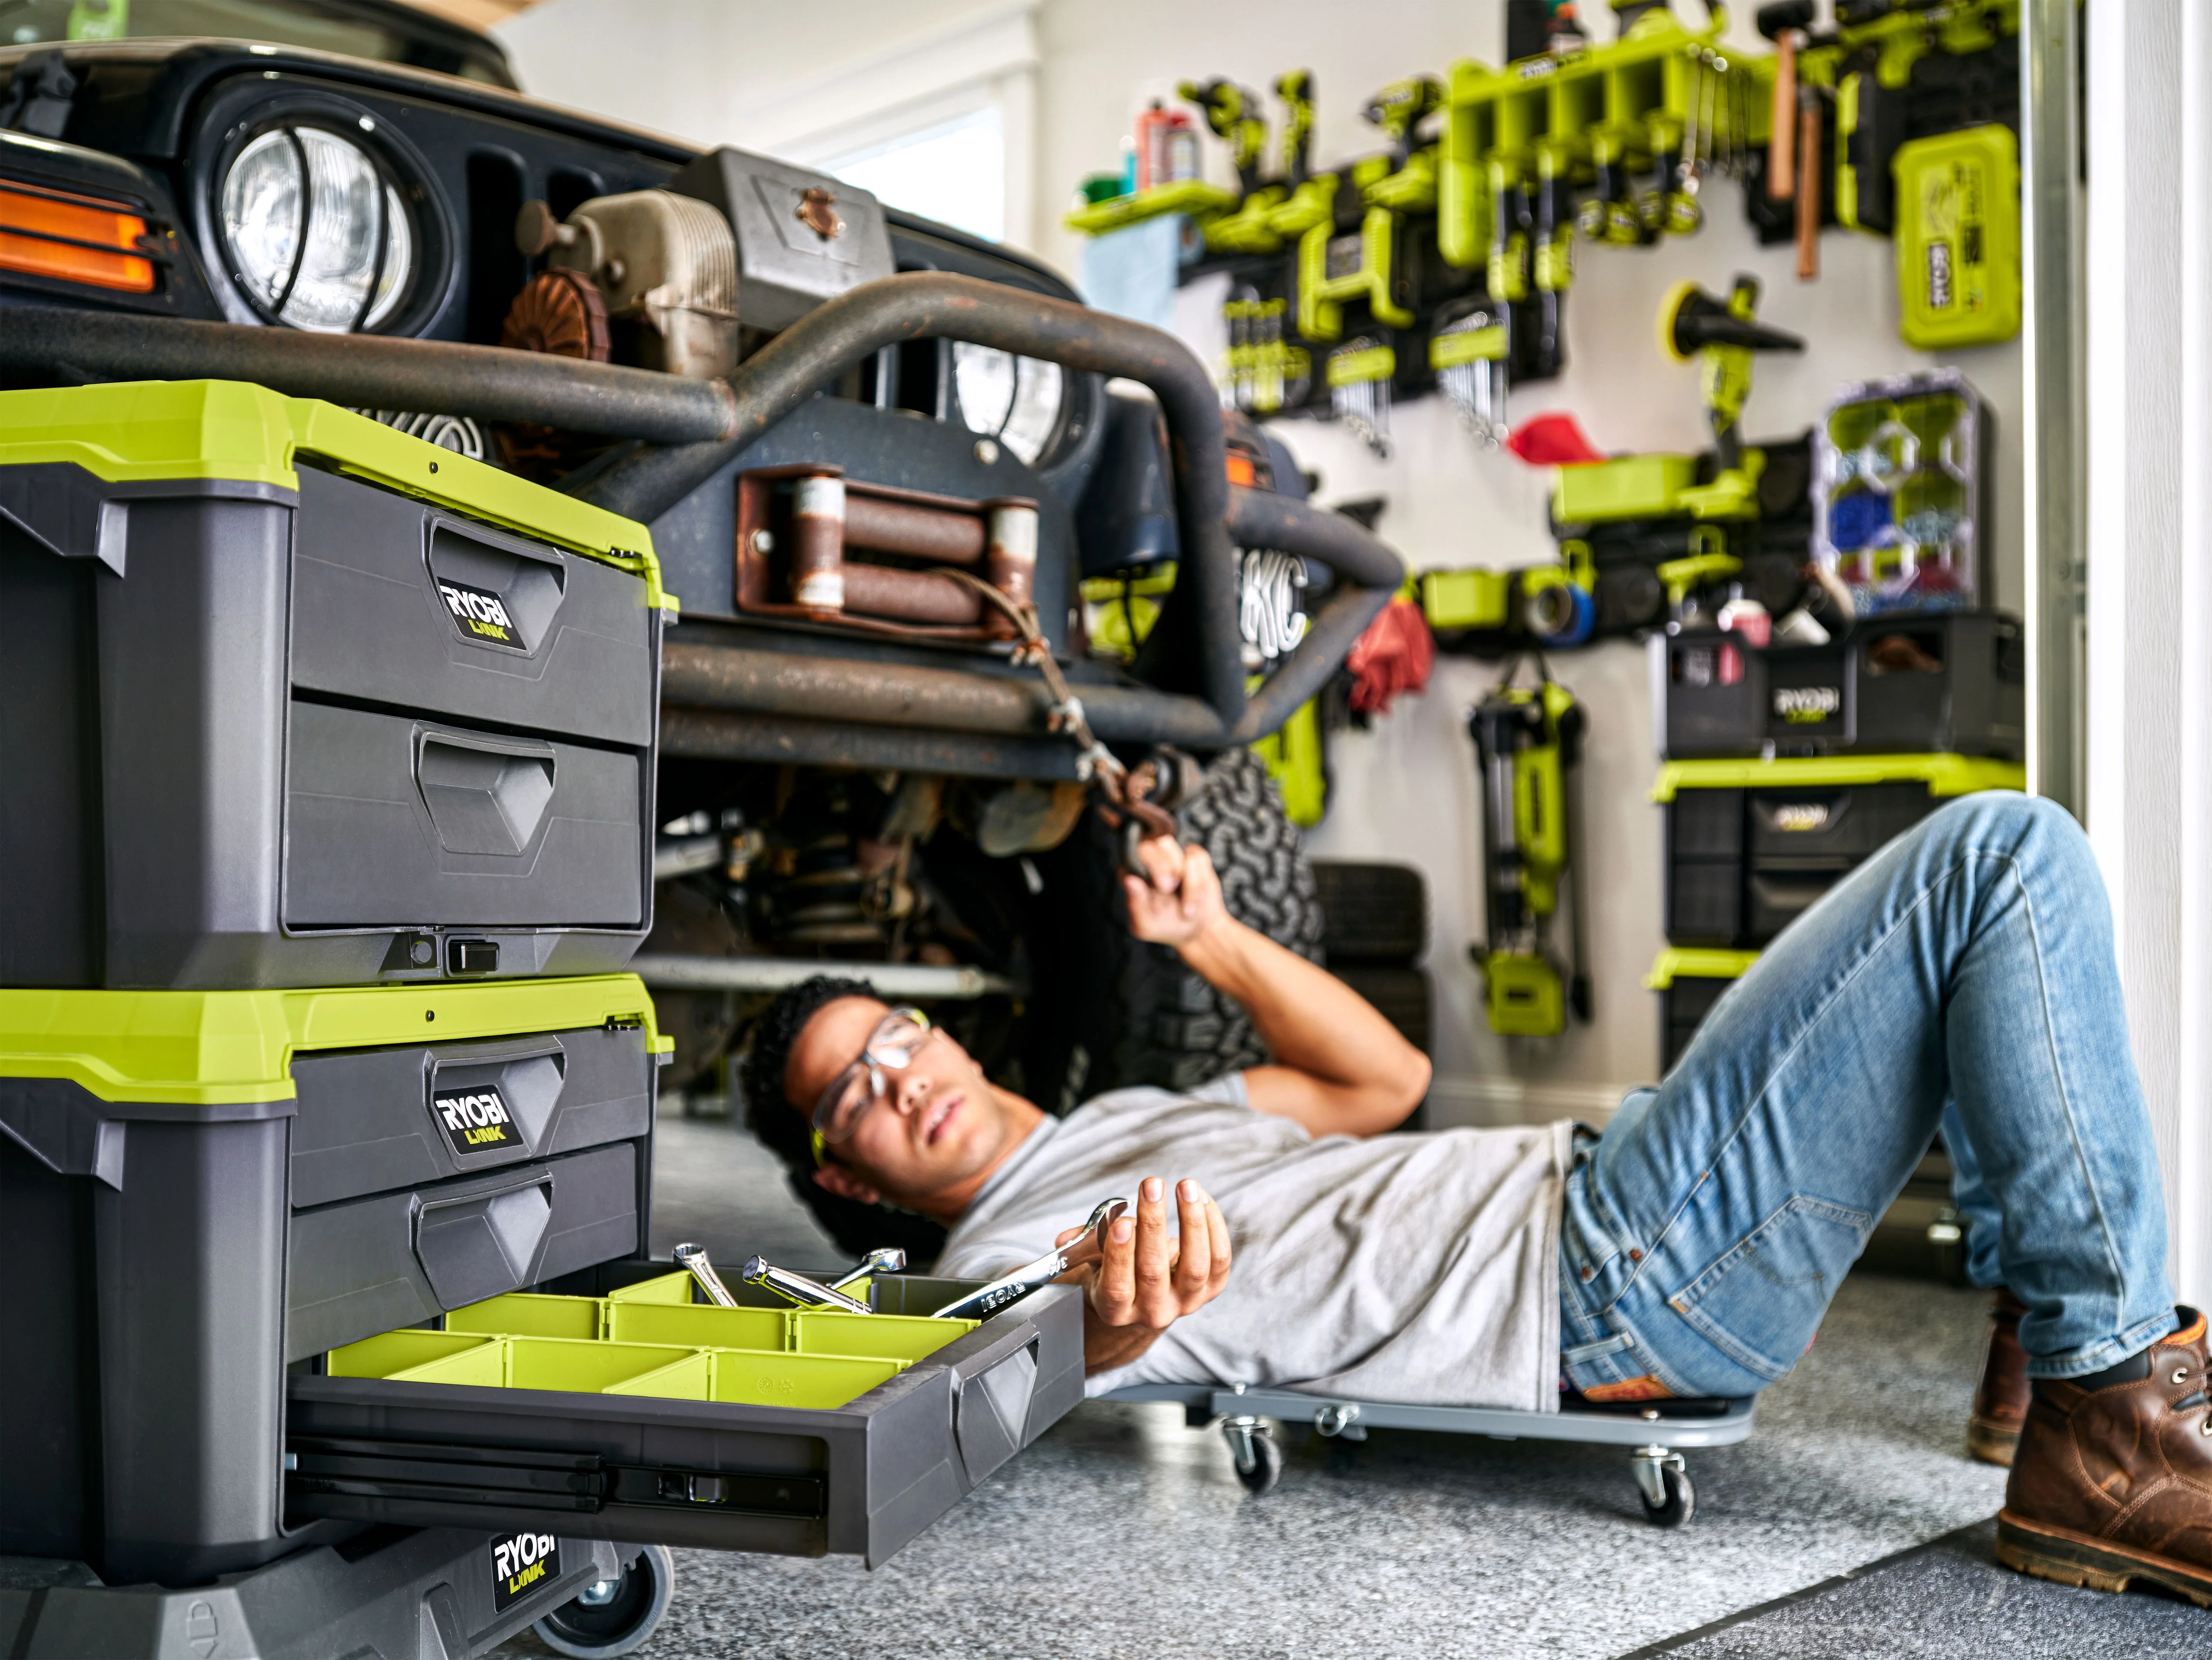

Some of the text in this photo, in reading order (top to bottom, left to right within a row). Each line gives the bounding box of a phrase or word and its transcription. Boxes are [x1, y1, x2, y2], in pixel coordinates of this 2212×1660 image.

[439, 585, 512, 628] RYOBI
[435, 1093, 509, 1130] RYOBI
[981, 1279, 1027, 1312] RYOBI
